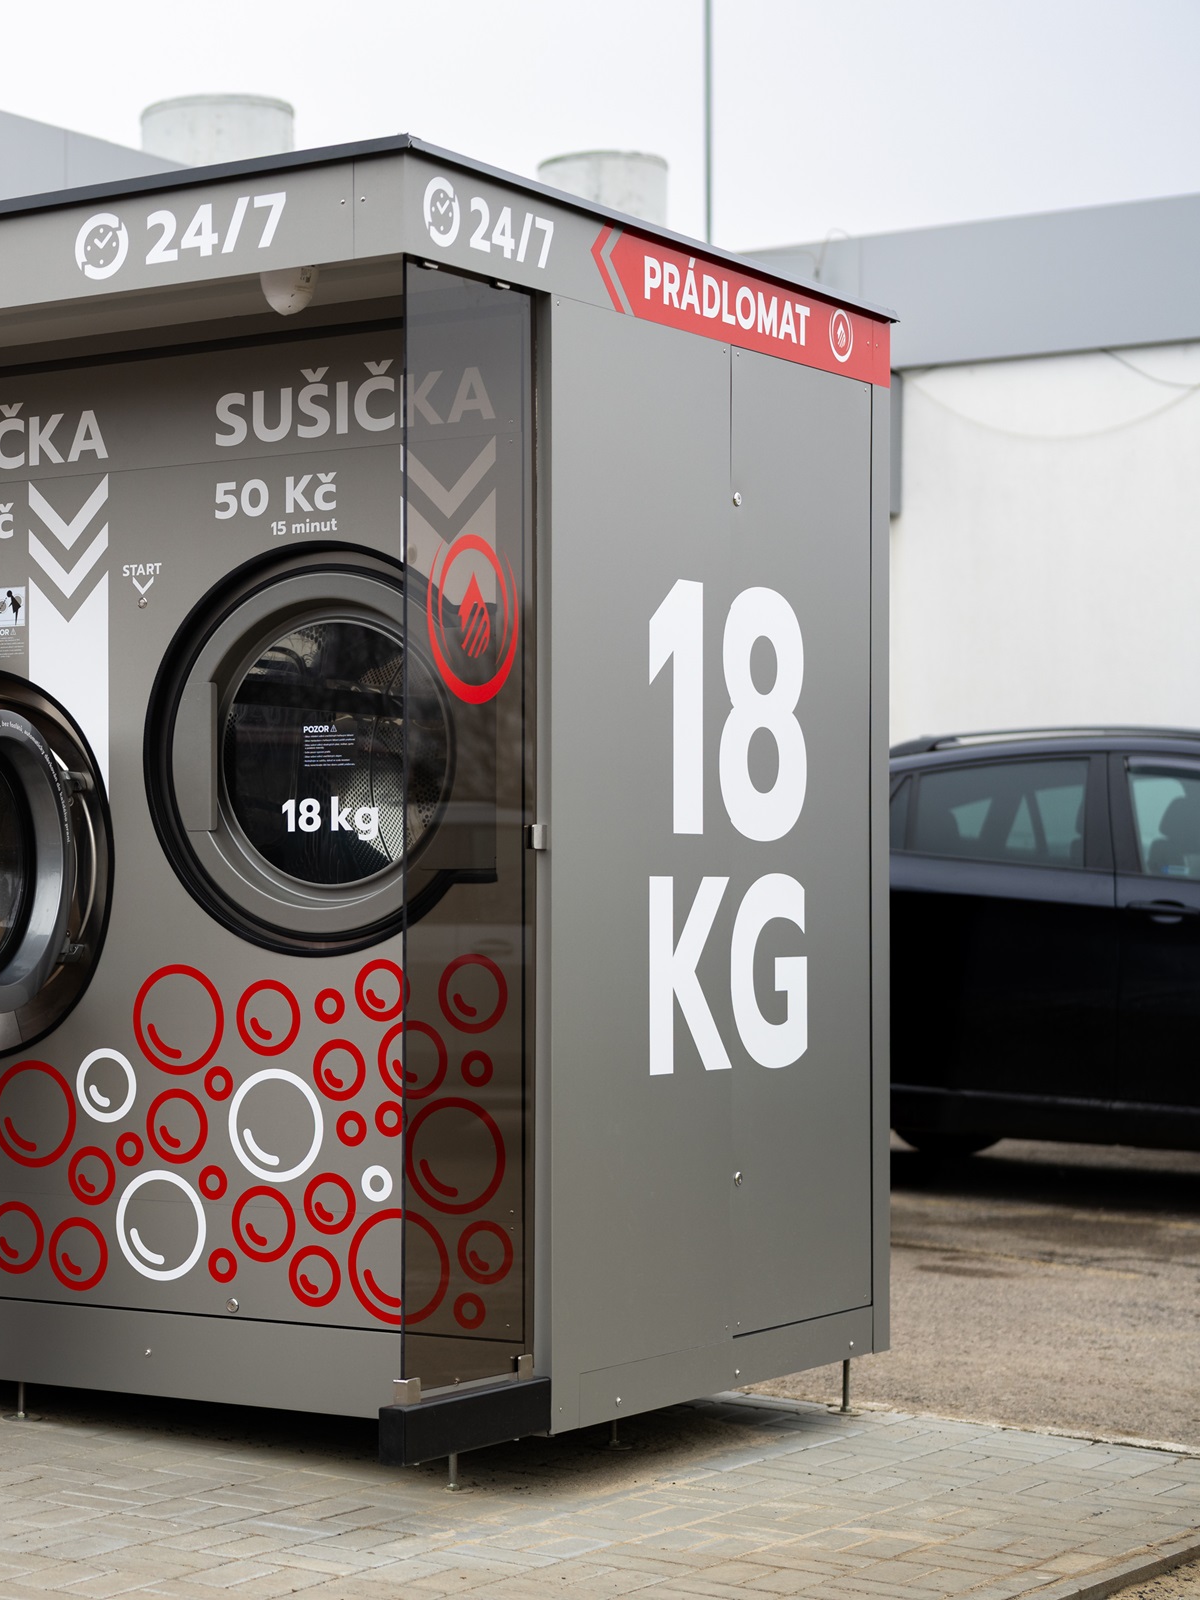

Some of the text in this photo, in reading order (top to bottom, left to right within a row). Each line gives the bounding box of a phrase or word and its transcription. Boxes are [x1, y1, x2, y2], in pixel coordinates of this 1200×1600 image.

[145, 192, 287, 265] 24/7
[469, 197, 554, 269] 24/7
[644, 255, 810, 347] PRÁDLOMAT
[215, 359, 497, 447] SUŠIČKA
[215, 471, 337, 519] 50 Kč
[270, 518, 337, 535] 15 minut
[122, 562, 162, 577] START
[303, 725, 329, 733] POZOR
[649, 578, 807, 842] 18
[281, 795, 379, 841] 18 kg
[649, 872, 808, 1076] KG
